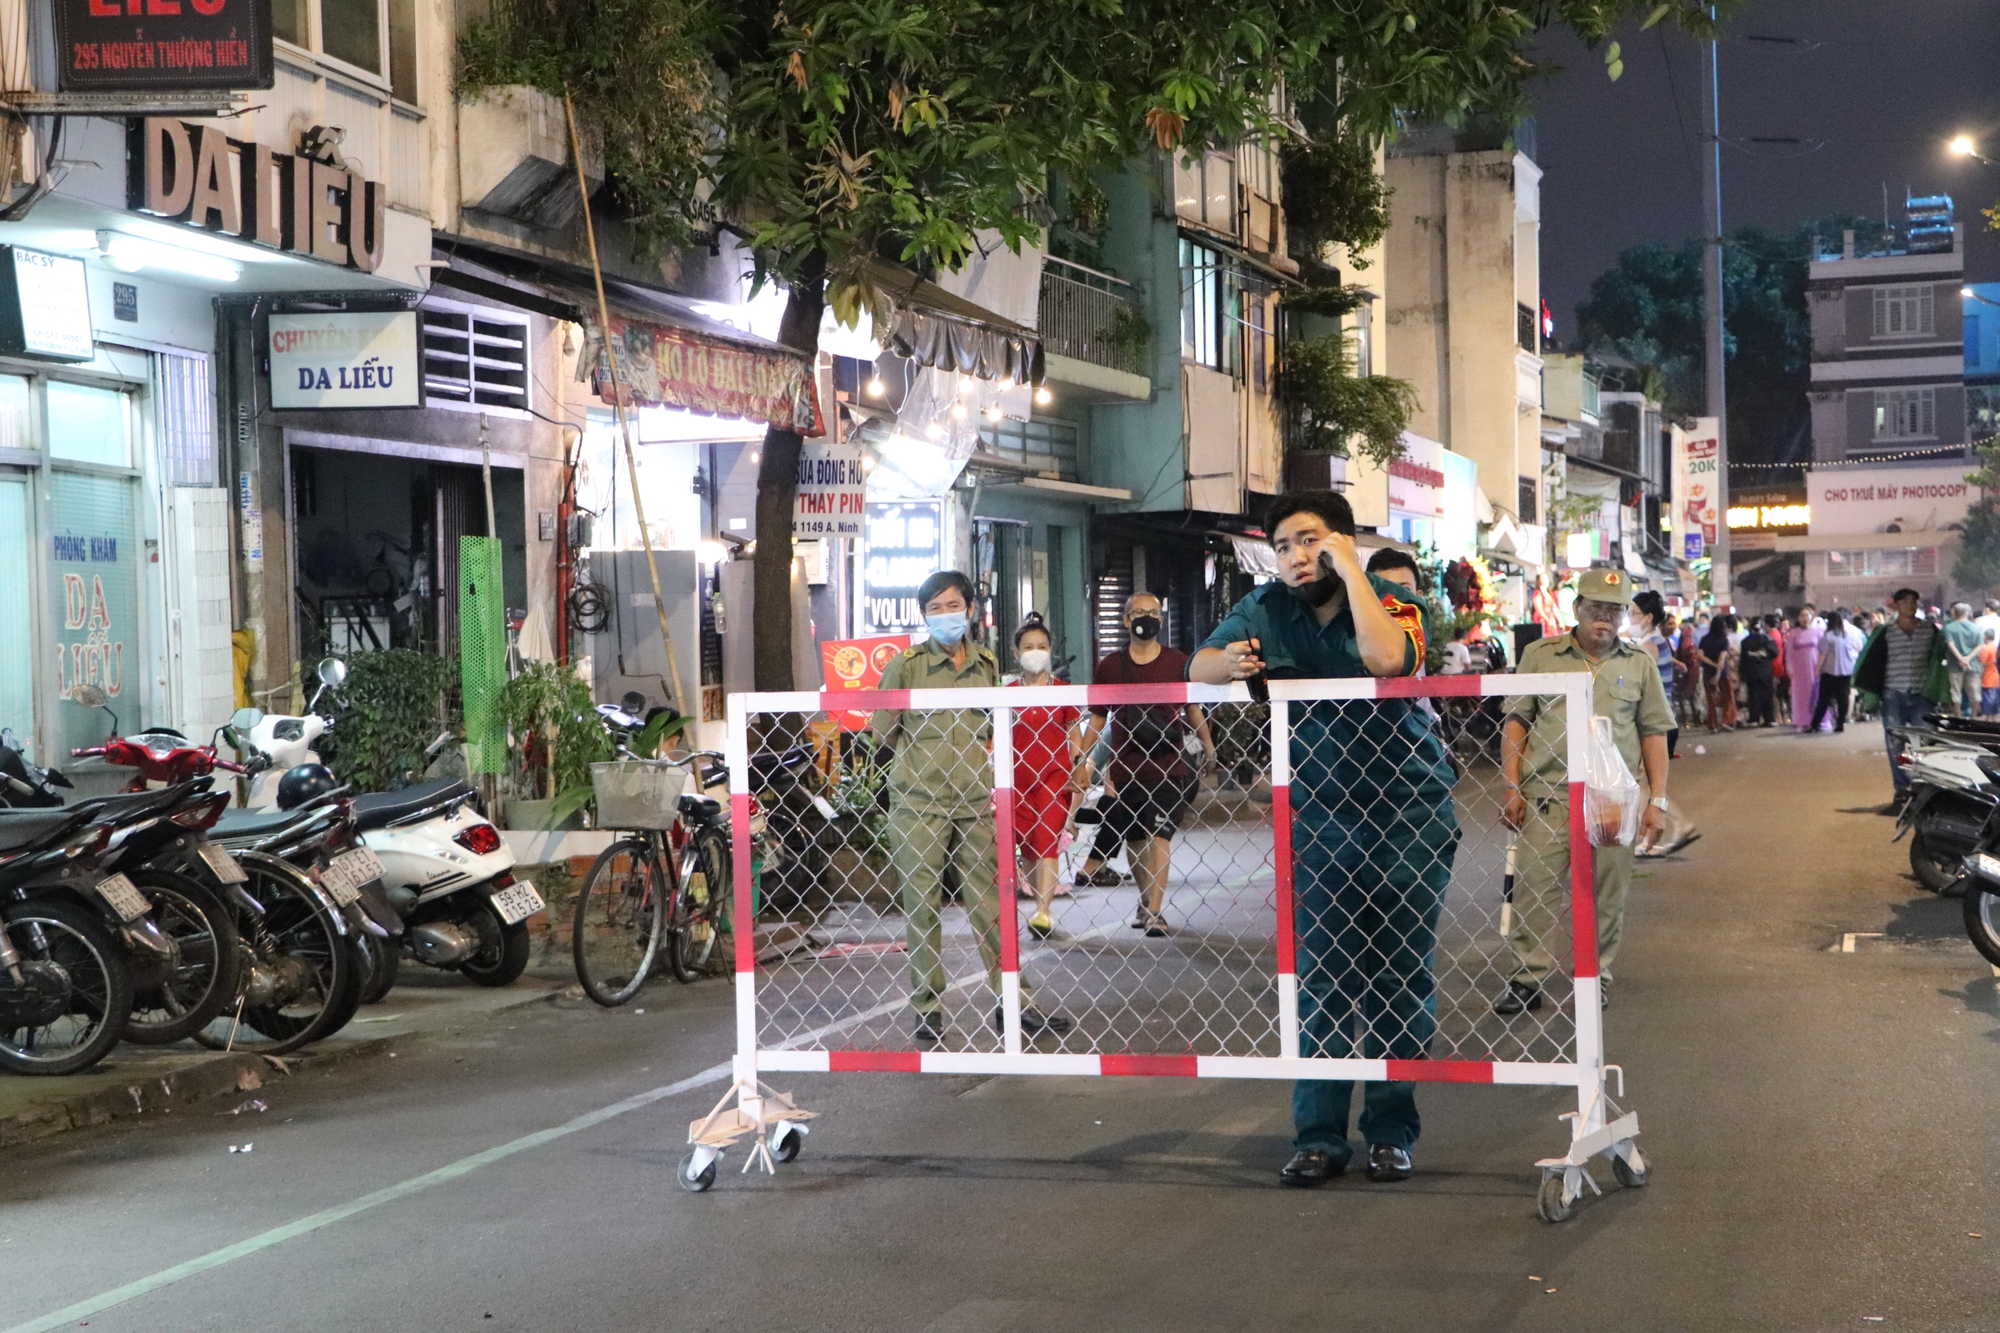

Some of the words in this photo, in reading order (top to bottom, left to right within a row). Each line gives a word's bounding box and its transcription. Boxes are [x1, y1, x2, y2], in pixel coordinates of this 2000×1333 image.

[74, 43, 98, 69] 295
[102, 28, 155, 69] NGUYỄN
[157, 37, 213, 73] THƯỢNG
[145, 117, 242, 236] DA
[115, 285, 135, 306] 295
[299, 367, 332, 390] DA
[339, 357, 393, 389] LIỄU
[1689, 459, 1716, 474] 20K
[799, 493, 835, 514] THAY
[840, 493, 863, 514] PIN
[1825, 488, 1848, 501] CHO
[1877, 483, 1898, 500] MÁY
[1902, 483, 1968, 499] PHOTOCOPY
[801, 521, 823, 533] 1149
[826, 521, 835, 533] A.
[837, 521, 859, 533] Ninh
[54, 529, 86, 562] PHÒNG
[91, 531, 117, 562] KHÁM
[64, 574, 111, 631] DA
[871, 597, 925, 627] VOLUM
[498, 884, 530, 906] 59-H2
